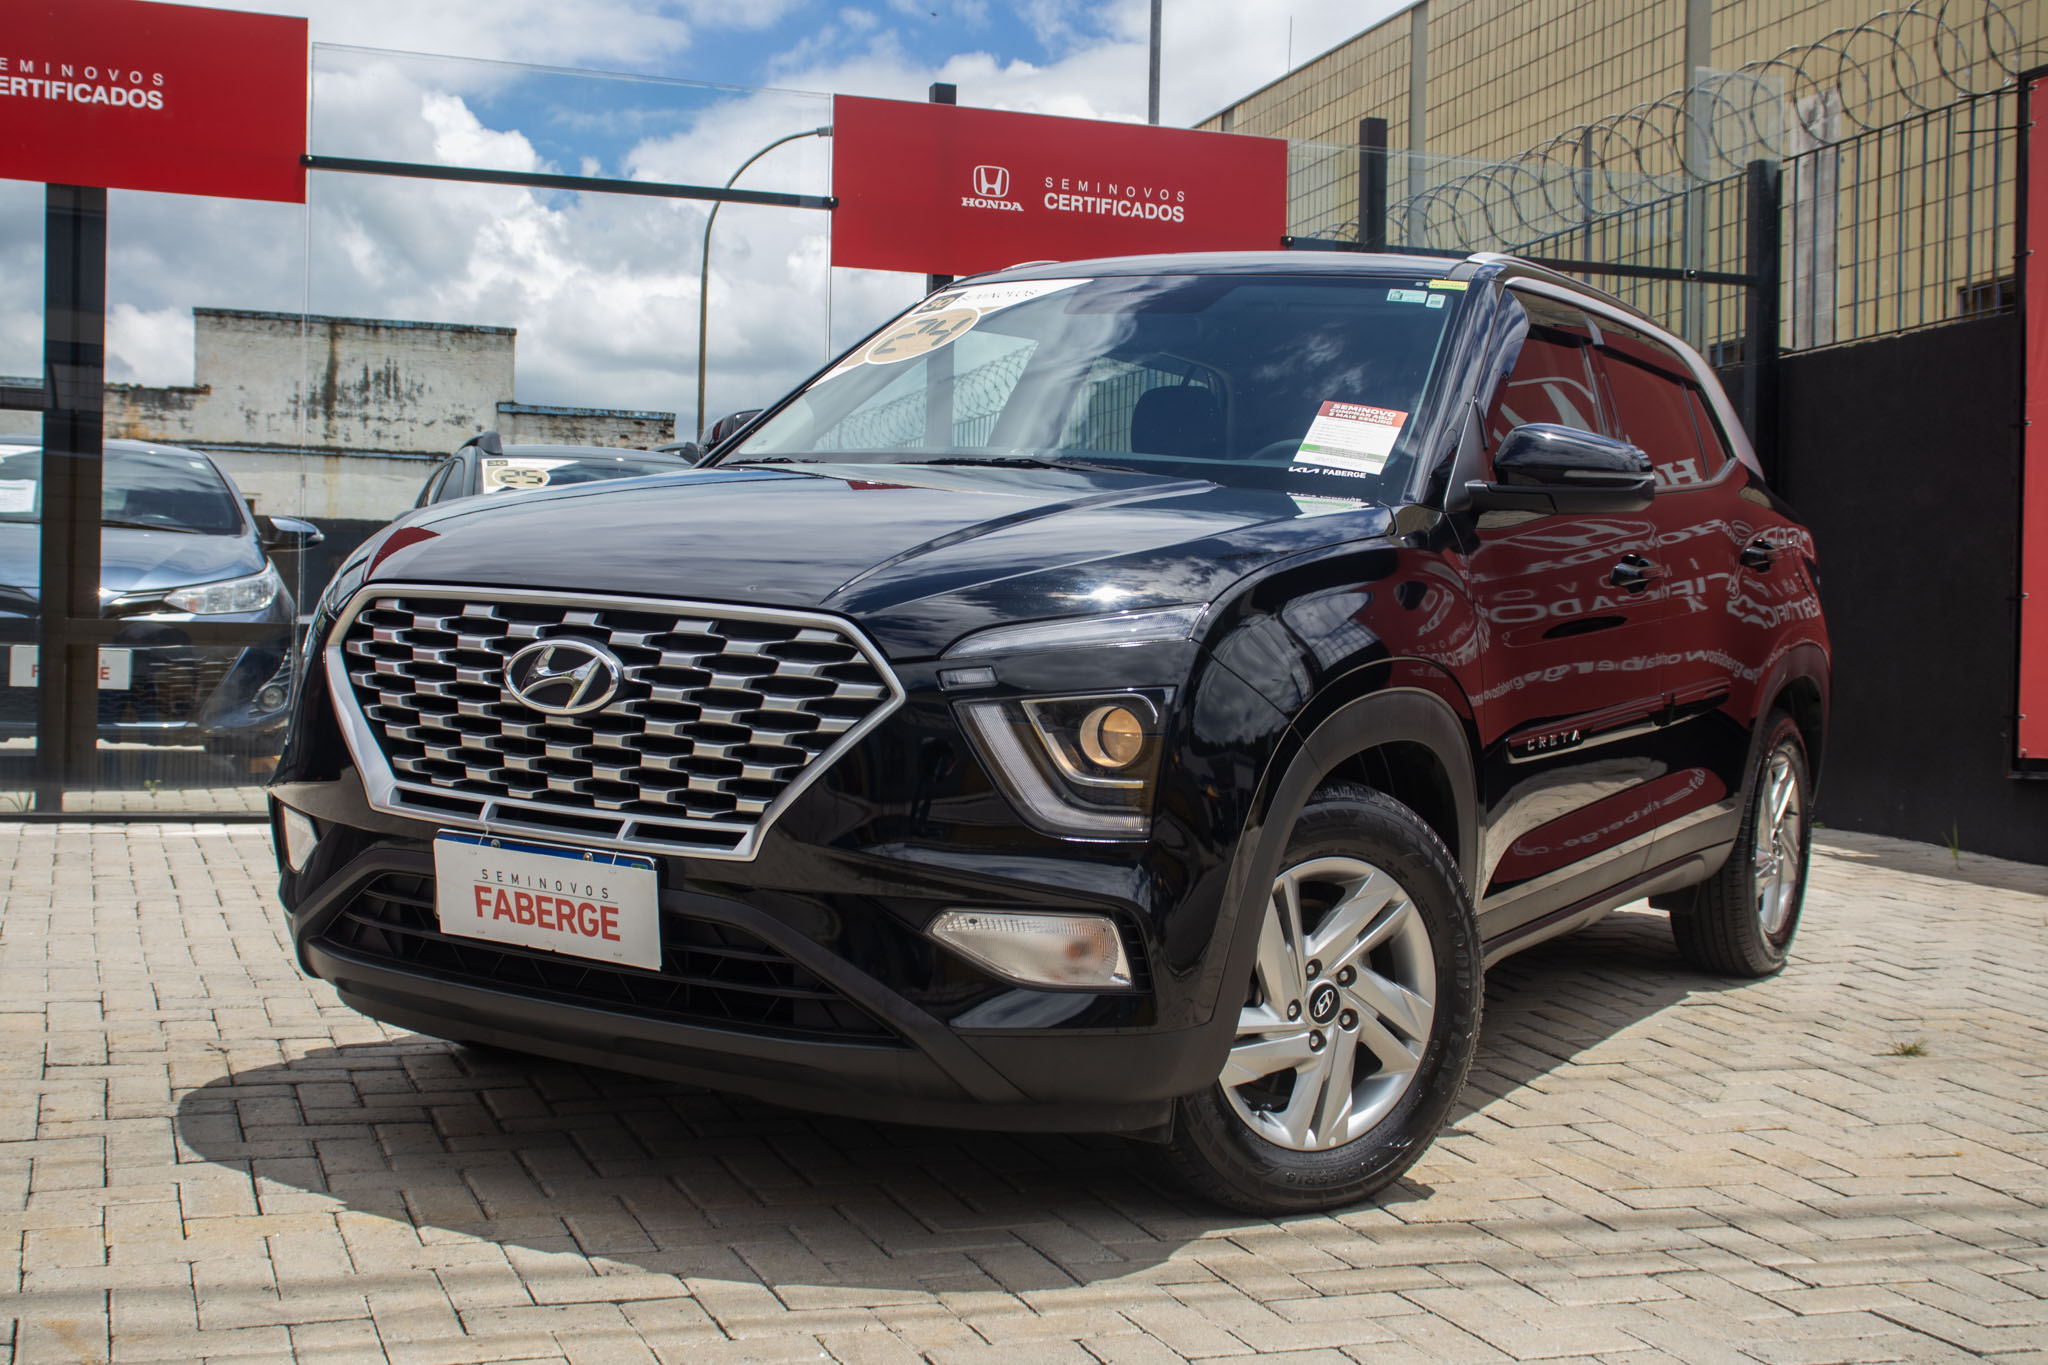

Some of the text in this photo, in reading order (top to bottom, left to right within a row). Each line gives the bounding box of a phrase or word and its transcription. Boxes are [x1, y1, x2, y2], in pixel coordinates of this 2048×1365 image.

[0, 57, 164, 86] EMINOVOS
[0, 75, 164, 110] ERTIFICADOS
[1045, 176, 1185, 202] SEMINOVOS
[961, 197, 1024, 212] HONDA
[1044, 192, 1185, 222] CERTIFICADOS
[1333, 403, 1397, 418] SEMINOVO
[500, 469, 543, 484] 25
[1322, 468, 1367, 479] FABERGE
[1527, 729, 1581, 751] CRETA
[481, 868, 609, 899] SEMINOVOS
[474, 884, 621, 942] FABERGE
